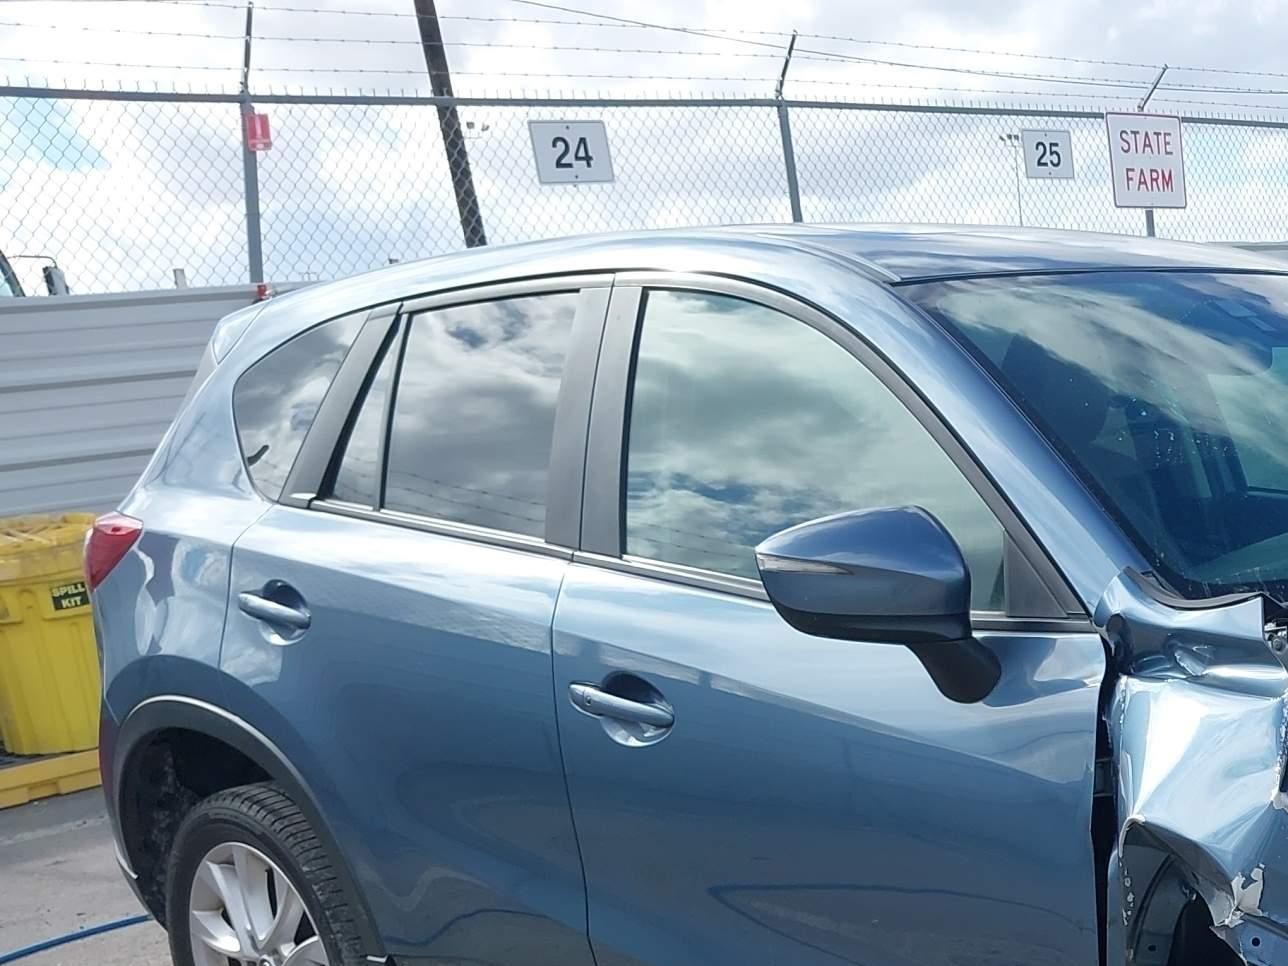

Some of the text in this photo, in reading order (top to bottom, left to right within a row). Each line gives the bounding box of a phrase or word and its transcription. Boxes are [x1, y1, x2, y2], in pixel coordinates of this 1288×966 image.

[552, 136, 594, 168] 24
[1035, 141, 1062, 167] 25
[1120, 130, 1173, 155] STATE
[1126, 168, 1174, 192] FARM
[52, 583, 86, 598] SPILL
[61, 596, 82, 609] KIT
